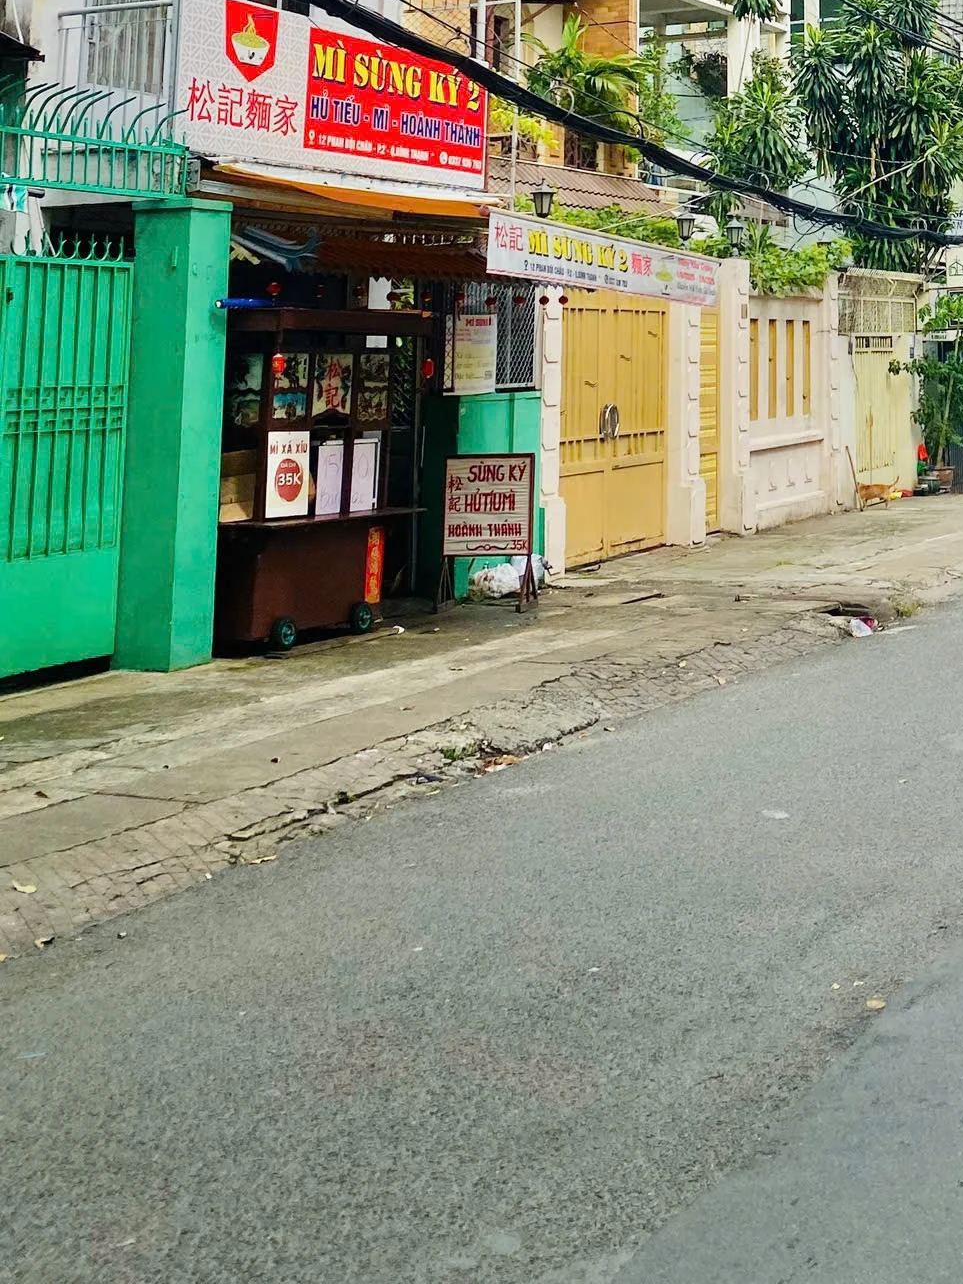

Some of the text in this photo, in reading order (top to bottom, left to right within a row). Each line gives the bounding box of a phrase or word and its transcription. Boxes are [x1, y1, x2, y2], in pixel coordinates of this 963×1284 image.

[312, 40, 480, 111] MÌ SÙNG KÝ 2
[310, 89, 329, 120] HỦ
[332, 95, 361, 126] TIẾU
[372, 104, 389, 132] MÌ
[444, 120, 481, 148] THÁNH
[495, 220, 524, 251] 松記
[618, 248, 629, 272] 2
[324, 356, 341, 409] 松記
[270, 441, 278, 455] MÌ
[281, 440, 292, 454] XÁ
[278, 472, 301, 486] 35K
[467, 461, 526, 483] SÙNG KÝ
[448, 519, 521, 537] HOÀNH THÁNH
[510, 540, 528, 551] 35K
